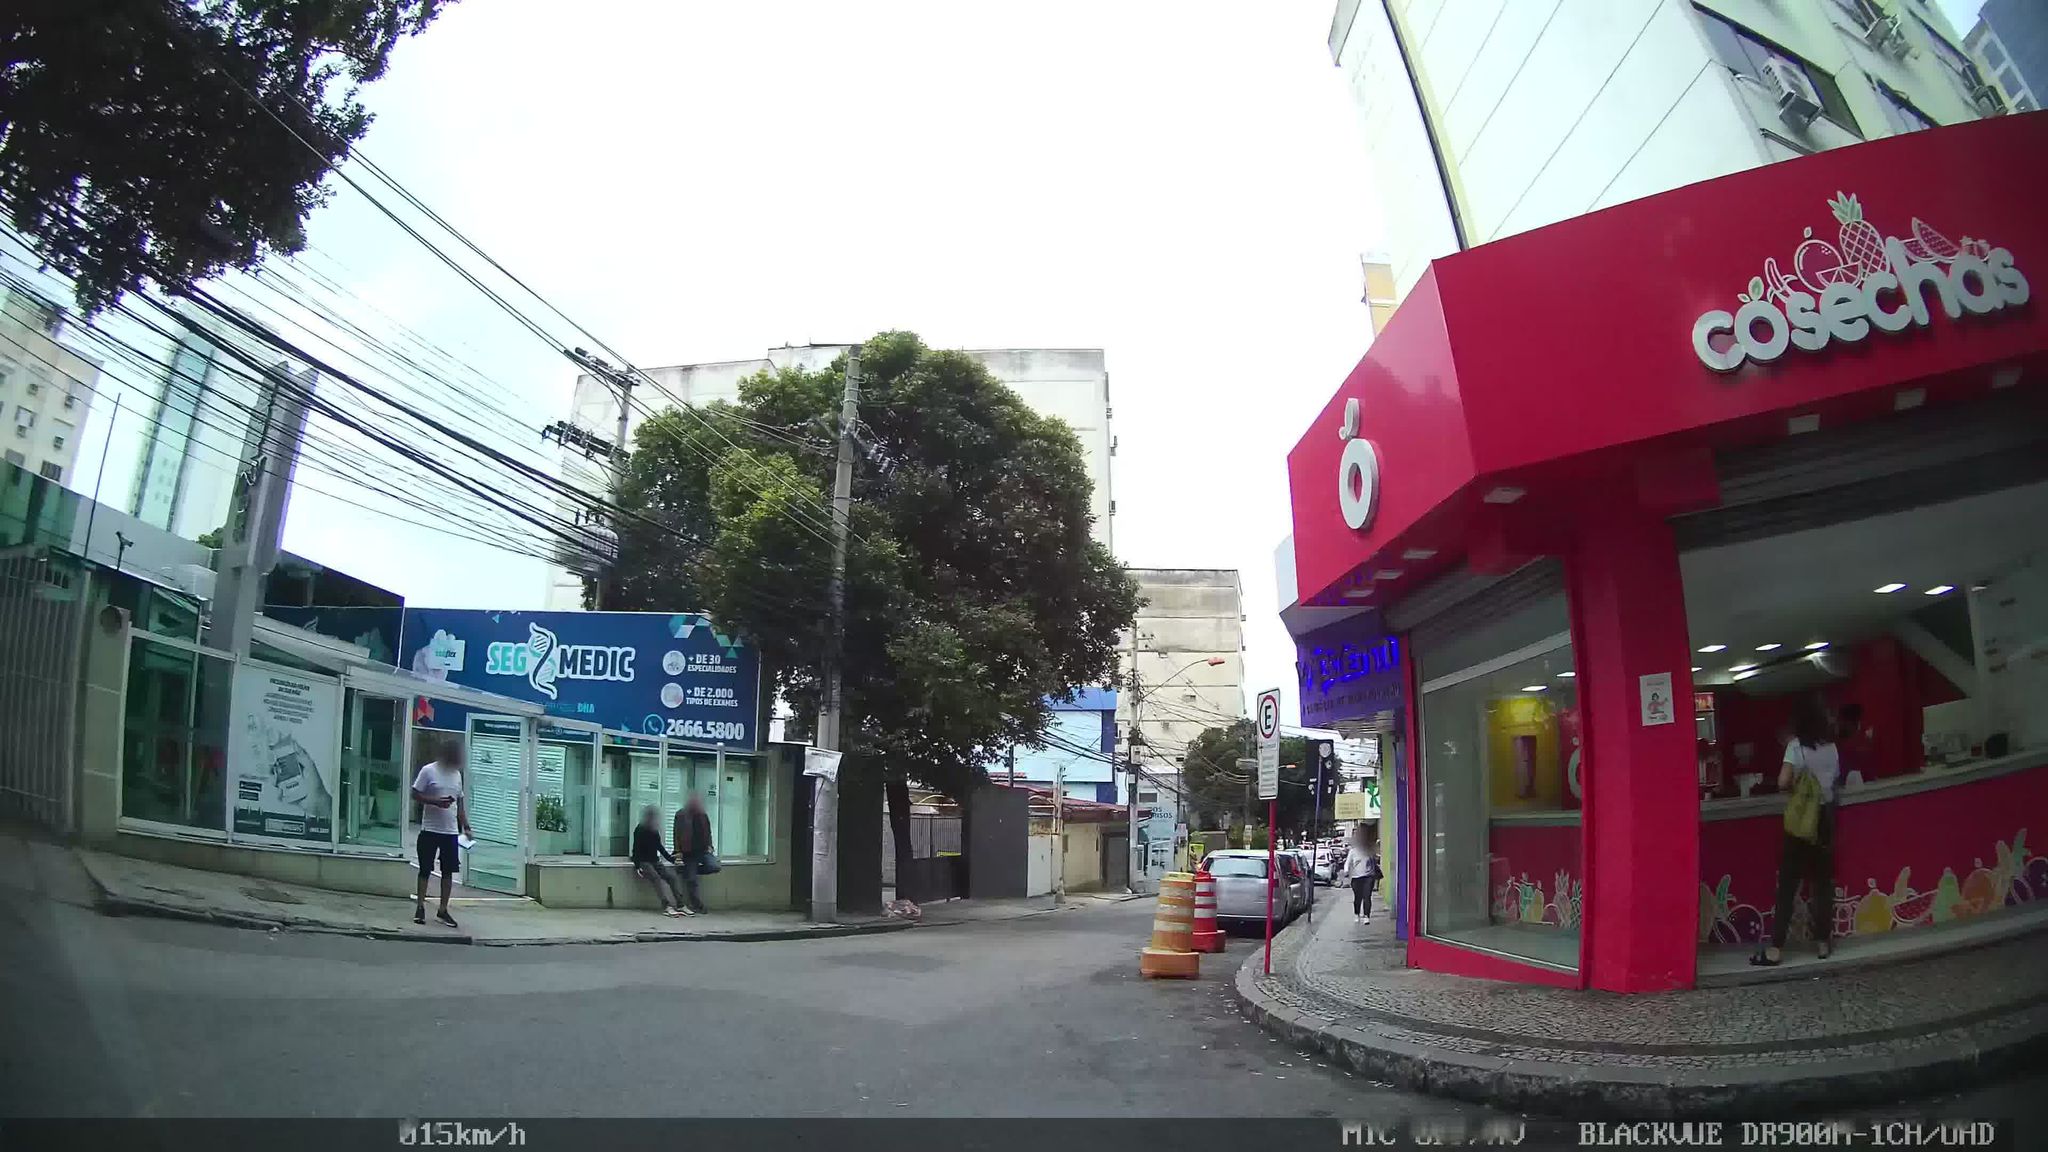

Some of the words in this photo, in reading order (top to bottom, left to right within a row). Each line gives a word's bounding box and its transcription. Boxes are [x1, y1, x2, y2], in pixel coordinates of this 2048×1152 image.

[1692, 236, 2030, 371] cosechas
[487, 643, 527, 675] SEG
[558, 646, 635, 681] MEDIC
[695, 653, 708, 664] DE
[709, 654, 721, 665] 30
[687, 664, 737, 674] ESPECIALIDADES
[694, 687, 706, 698] DE
[706, 687, 734, 699] 2.000
[686, 697, 703, 706] TIPOS
[703, 698, 713, 706] DE
[713, 699, 739, 708] EXAMES
[1264, 704, 1272, 730] E
[666, 718, 745, 740] 2666.5800
